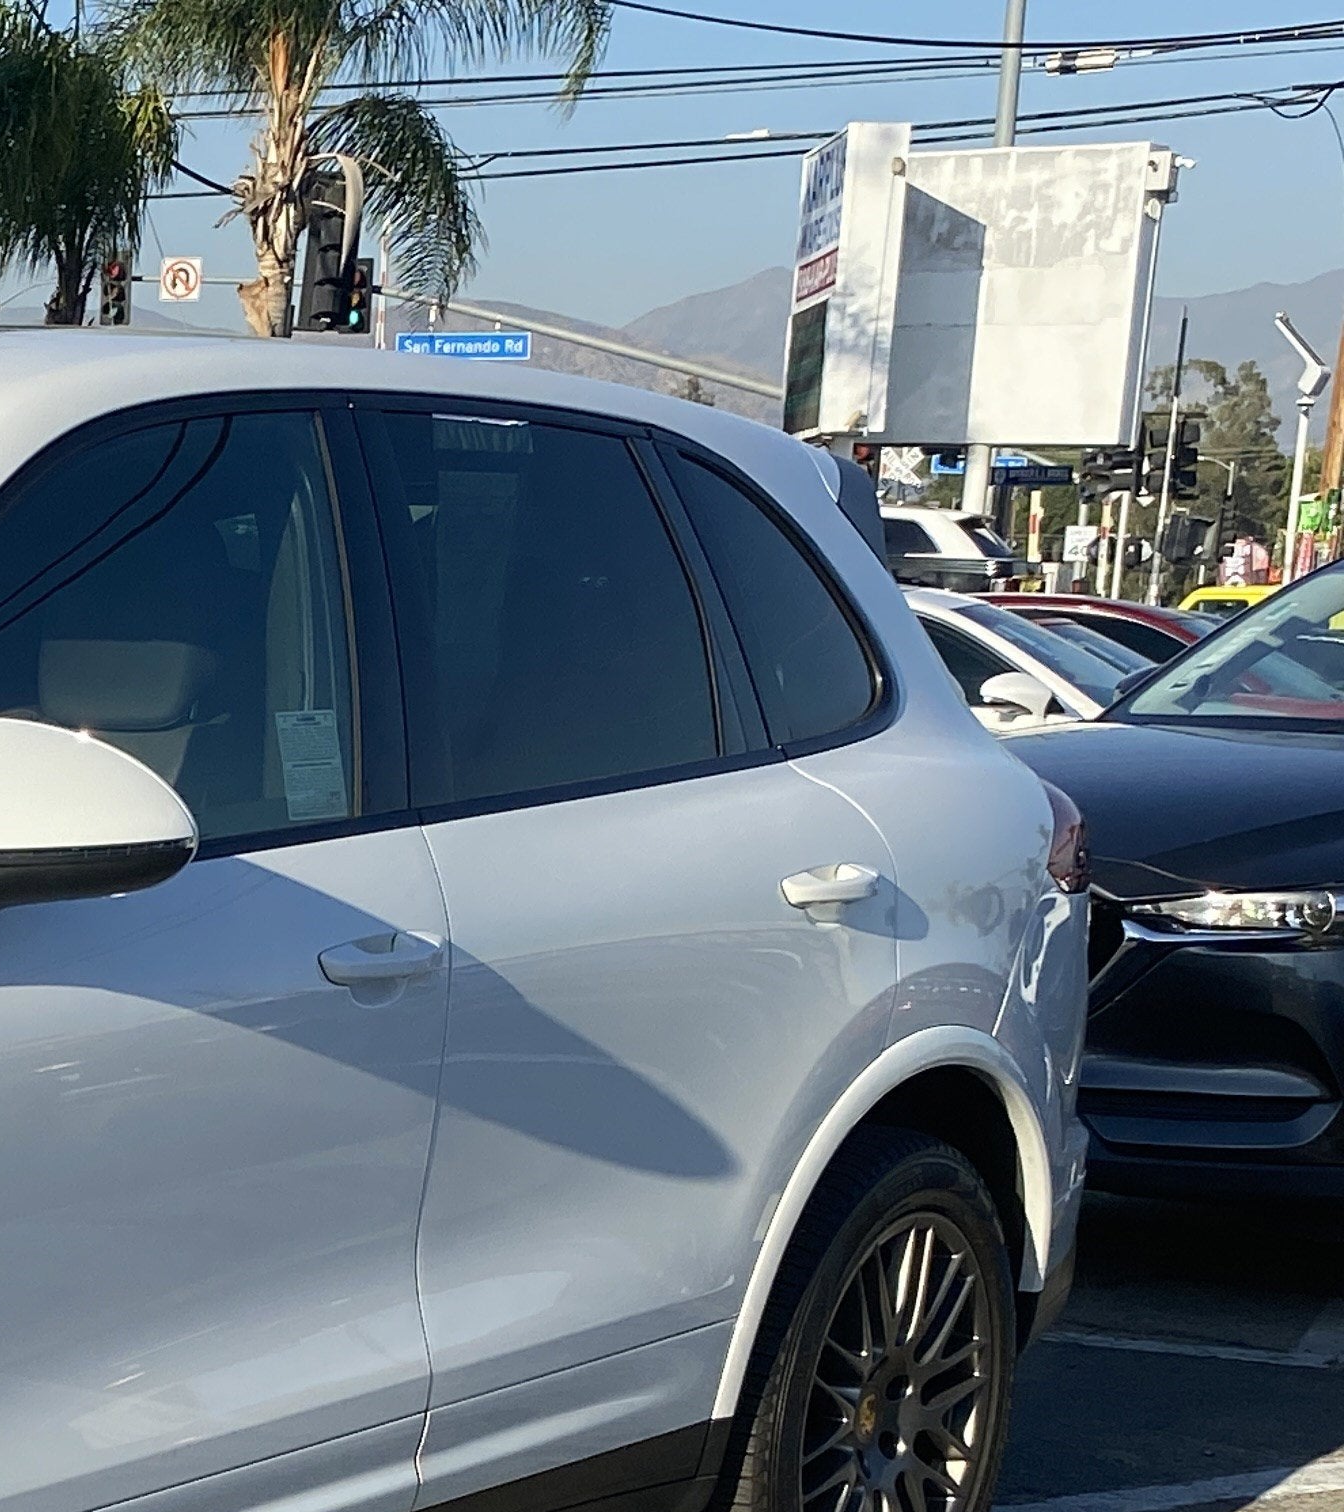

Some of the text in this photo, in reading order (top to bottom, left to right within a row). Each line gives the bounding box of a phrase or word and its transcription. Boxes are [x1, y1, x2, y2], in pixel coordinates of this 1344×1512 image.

[403, 339, 523, 354] San Fernando Rd
